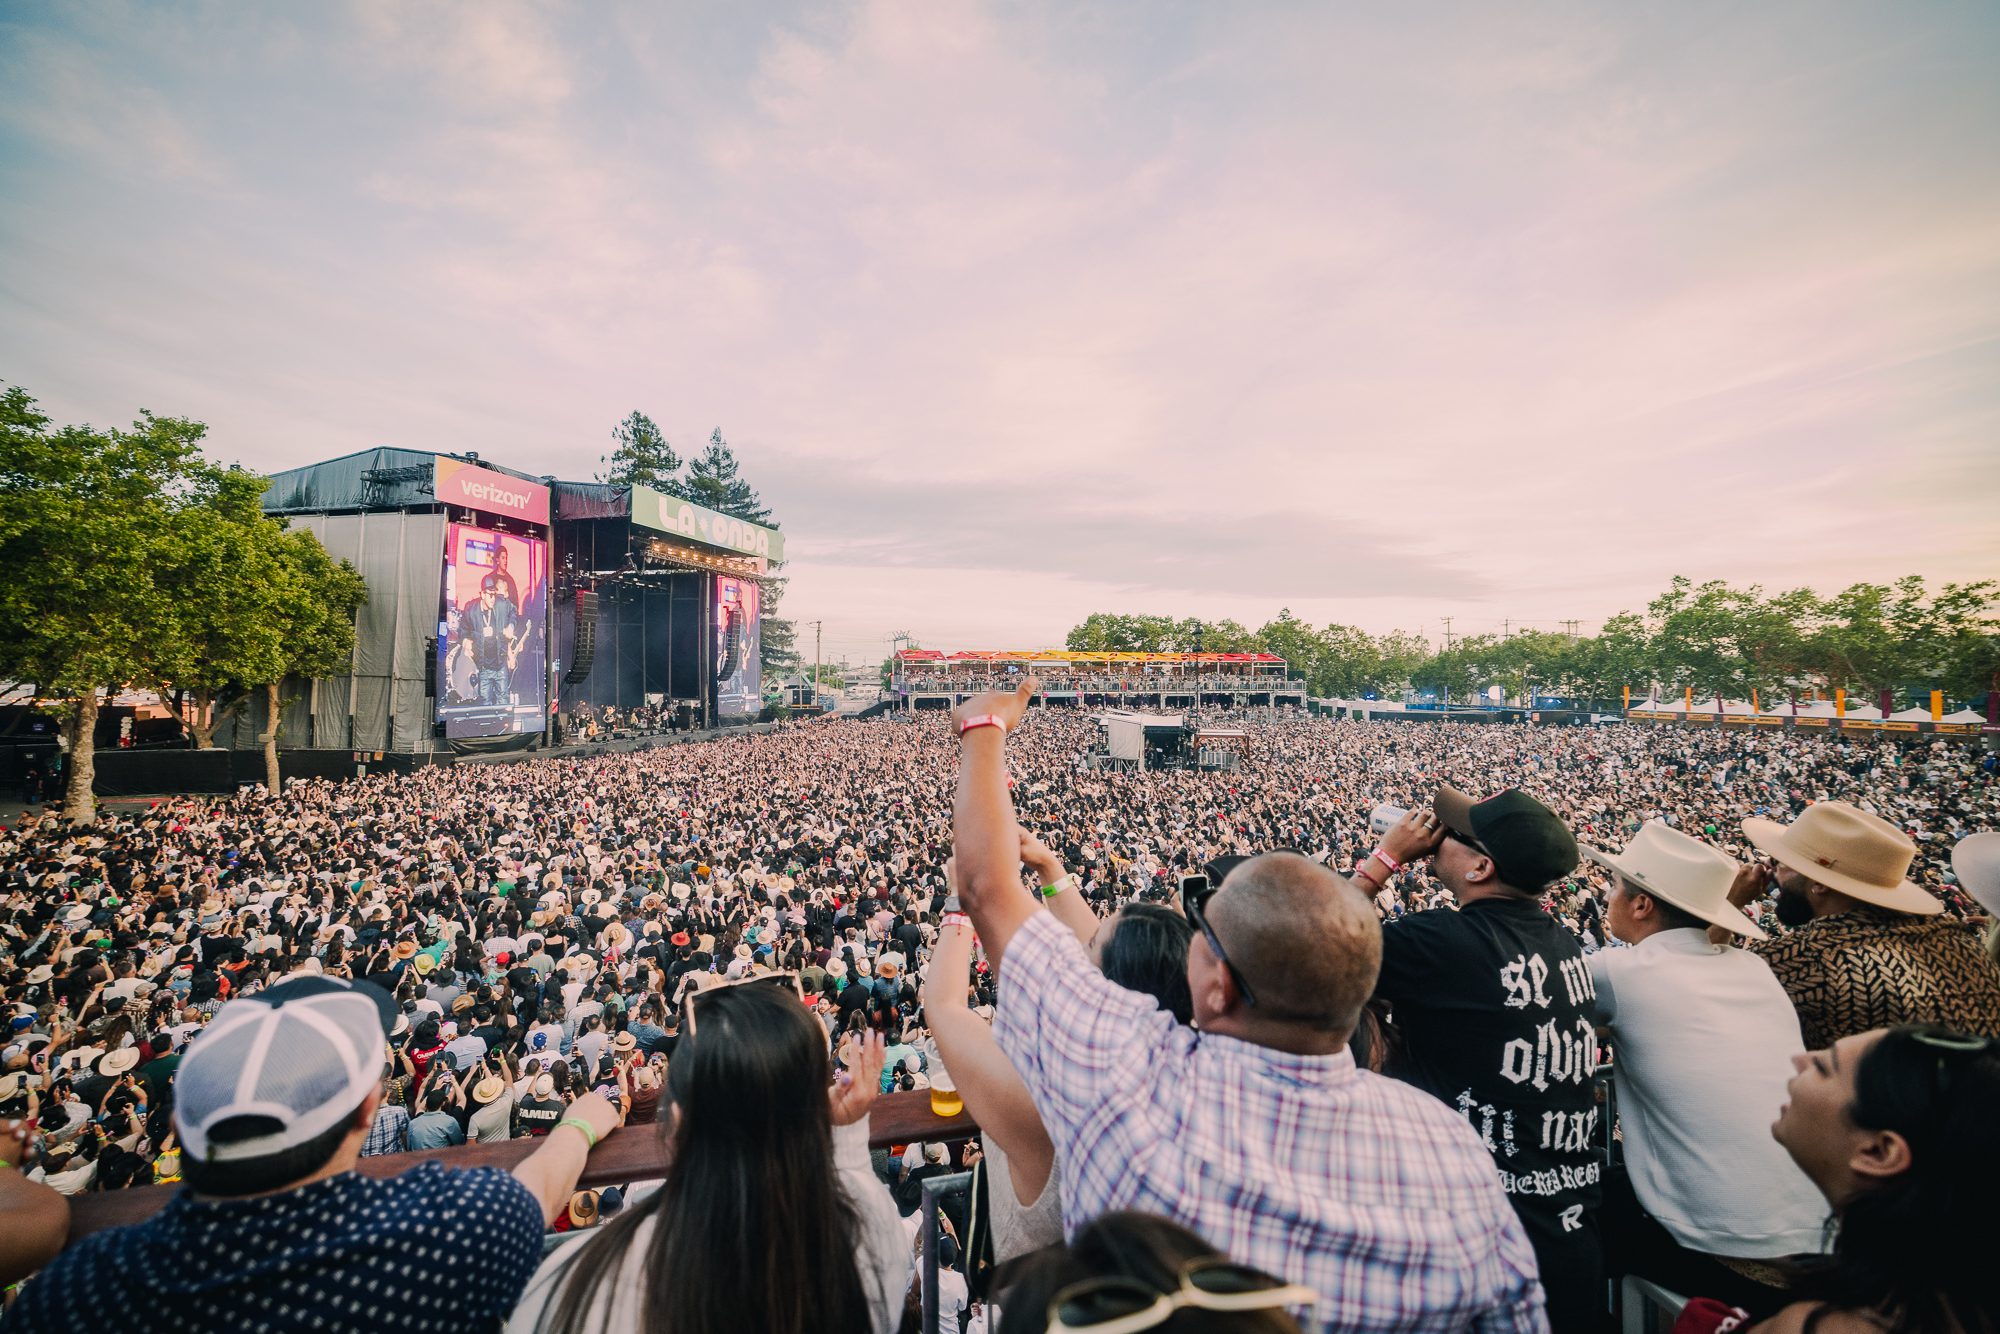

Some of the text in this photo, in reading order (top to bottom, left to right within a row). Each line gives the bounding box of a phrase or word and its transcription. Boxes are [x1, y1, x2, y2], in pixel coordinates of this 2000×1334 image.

[461, 479, 526, 510] verizon
[658, 496, 770, 557] LA ONDA
[1499, 952, 1553, 1010] se
[1499, 1013, 1598, 1093] olvid
